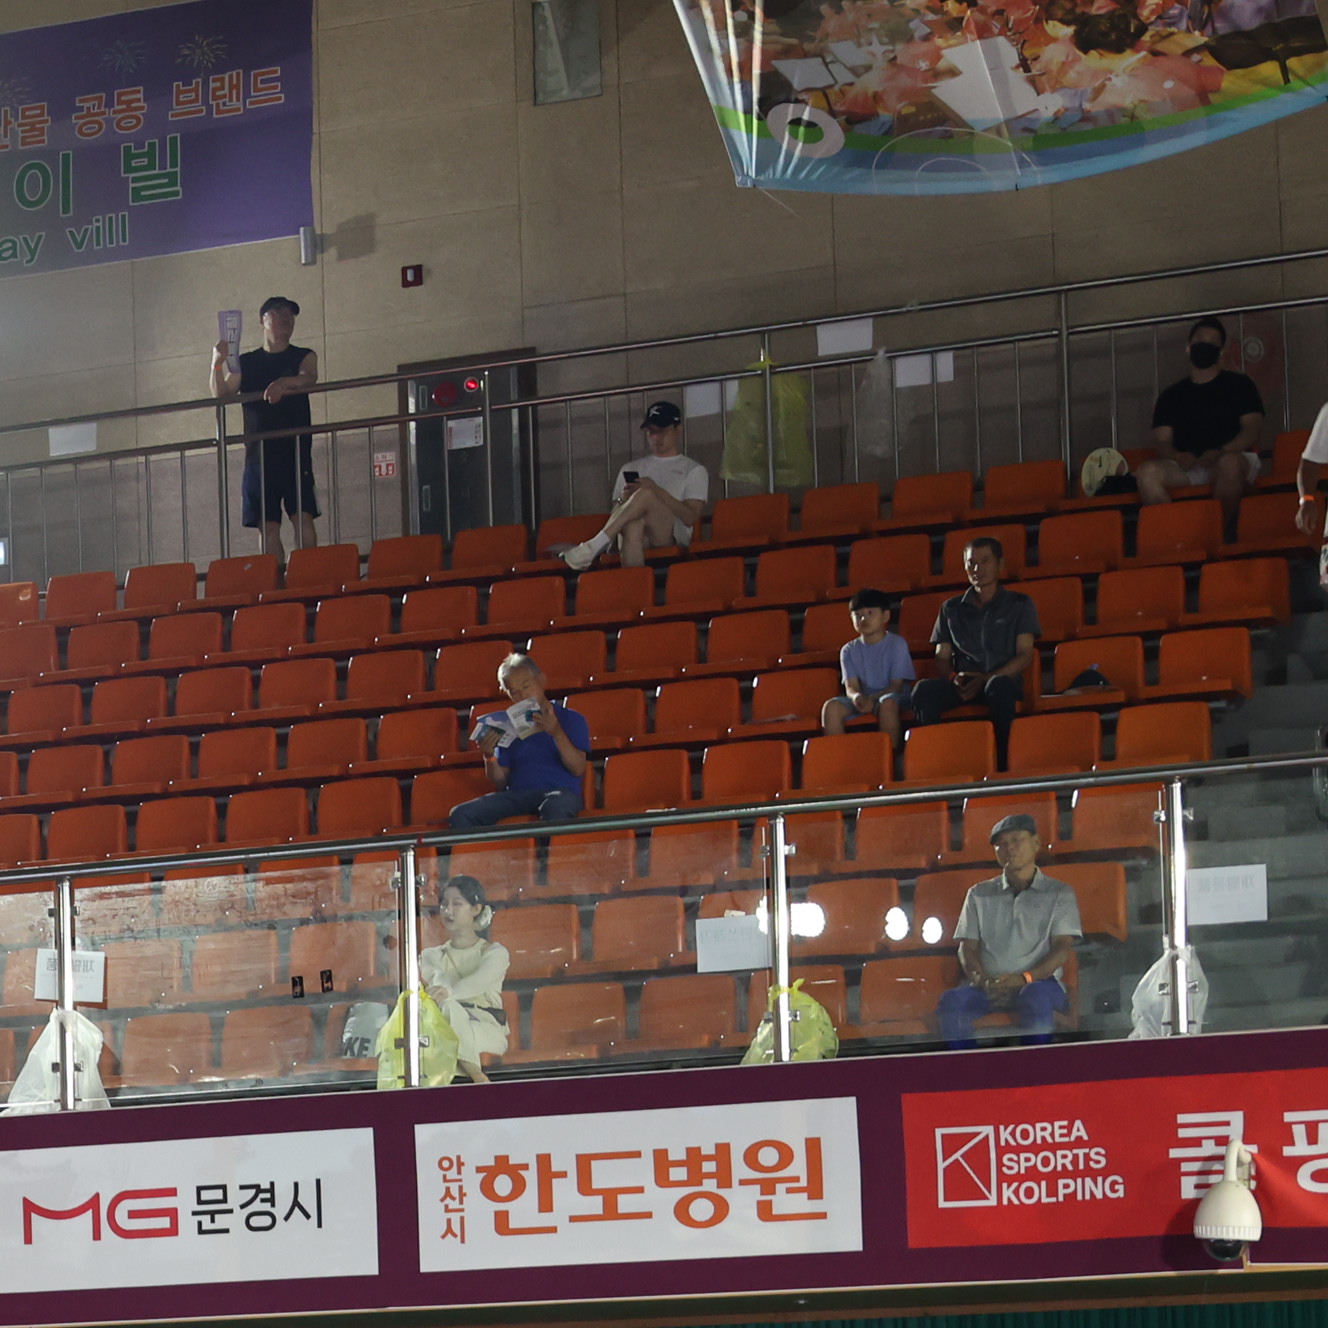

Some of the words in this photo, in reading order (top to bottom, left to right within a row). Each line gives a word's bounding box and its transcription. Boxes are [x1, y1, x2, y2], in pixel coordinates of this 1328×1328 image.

[72, 85, 147, 140] 공동
[169, 66, 285, 120] 브랜드
[66, 212, 130, 253] vill
[999, 1120, 1088, 1147] KOREA
[1002, 1147, 1106, 1174] SPORTS
[22, 1187, 178, 1244] MG
[191, 1178, 323, 1236] 문경시
[438, 1155, 467, 1244] 안산시
[475, 1137, 827, 1236] 한도병원
[1003, 1175, 1124, 1206] KOLPING
